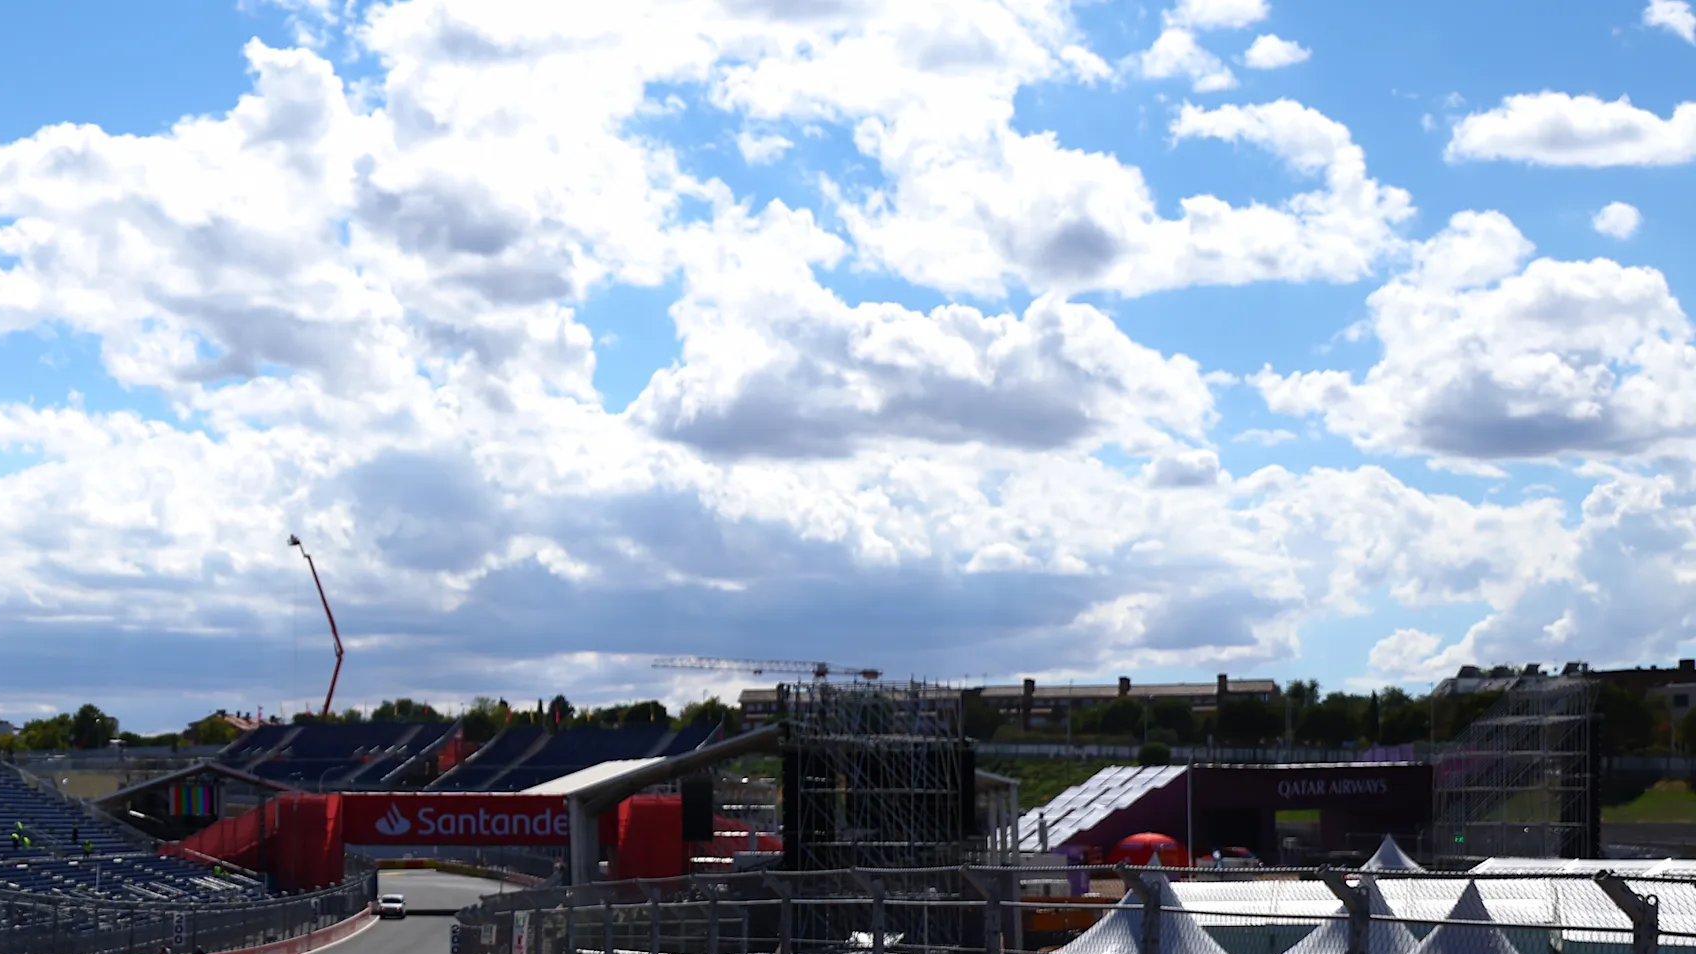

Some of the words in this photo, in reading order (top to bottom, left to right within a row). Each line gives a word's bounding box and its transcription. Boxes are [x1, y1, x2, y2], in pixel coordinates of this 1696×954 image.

[1277, 780, 1324, 799] QATAR
[1329, 779, 1387, 794] AIRWAYS
[418, 808, 570, 834] Santande
[174, 914, 183, 944] 200
[451, 924, 459, 954] 200
